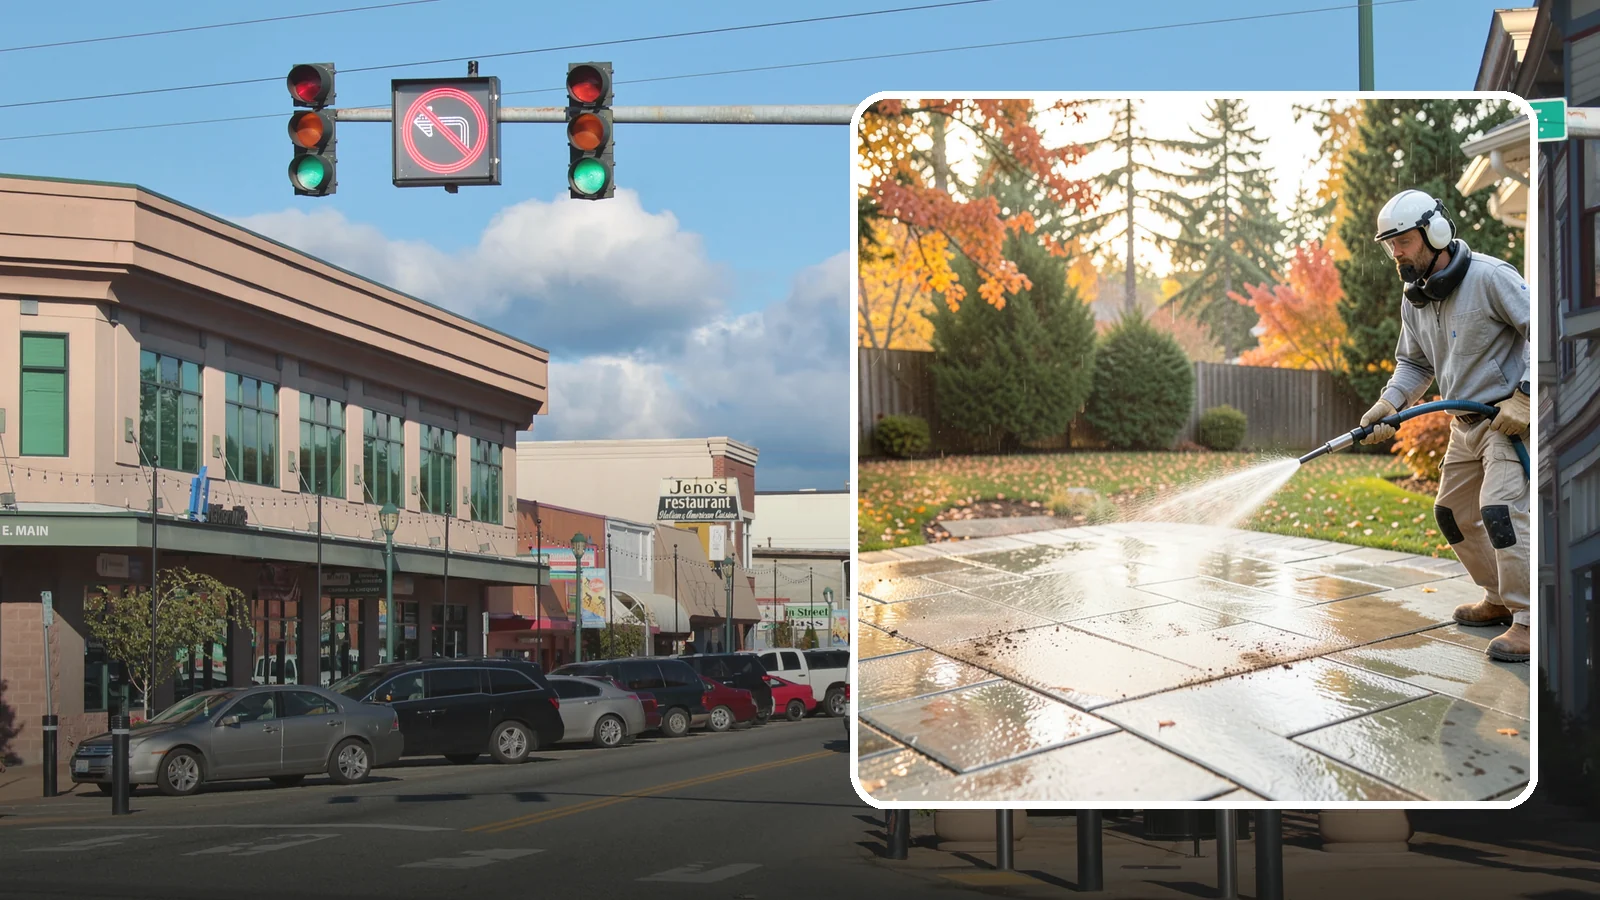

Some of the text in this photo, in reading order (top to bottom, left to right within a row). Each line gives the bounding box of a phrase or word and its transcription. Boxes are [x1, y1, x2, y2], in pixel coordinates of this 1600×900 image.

[670, 480, 728, 494] Jeno's
[665, 496, 730, 509] restaurant
[658, 510, 682, 519] Italian
[686, 510, 714, 519] American
[715, 509, 737, 519] Cuisine
[2, 525, 49, 537] E. MAIN
[797, 607, 828, 617] Street
